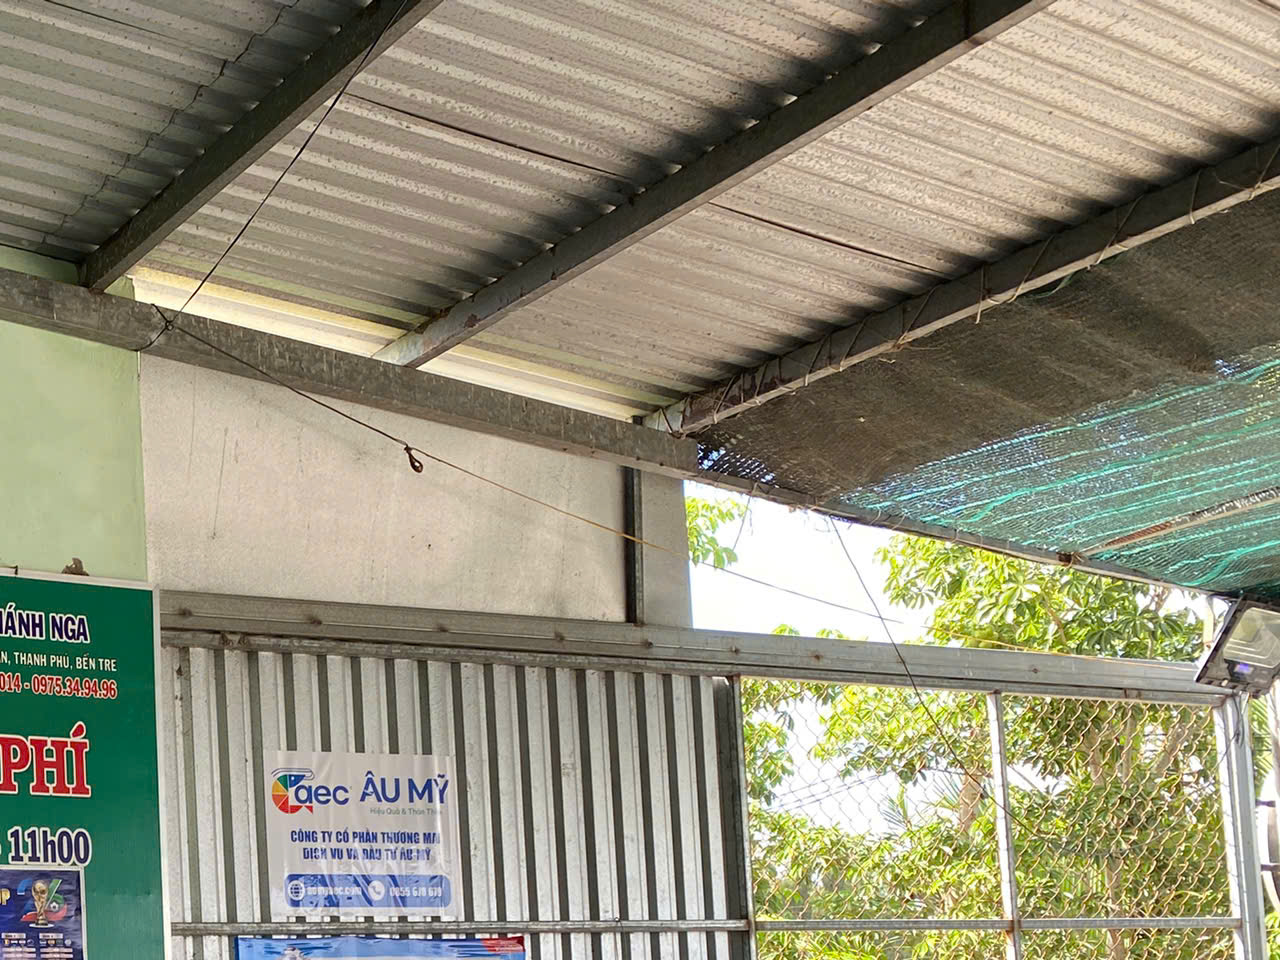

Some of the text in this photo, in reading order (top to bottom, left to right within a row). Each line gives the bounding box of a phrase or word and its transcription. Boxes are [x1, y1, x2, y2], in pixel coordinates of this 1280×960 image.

[50, 613, 90, 644] NGA
[14, 652, 47, 669] THẠNH
[50, 652, 73, 671] PHÚ,
[75, 652, 96, 671] BẾN
[98, 658, 117, 672] TRE
[32, 674, 118, 700] 0975.34.94.96
[360, 770, 400, 803] ÂU
[408, 773, 449, 804] MỸ
[8, 828, 92, 867] 11h00
[291, 829, 317, 843] CÔNG
[321, 831, 332, 843] TY
